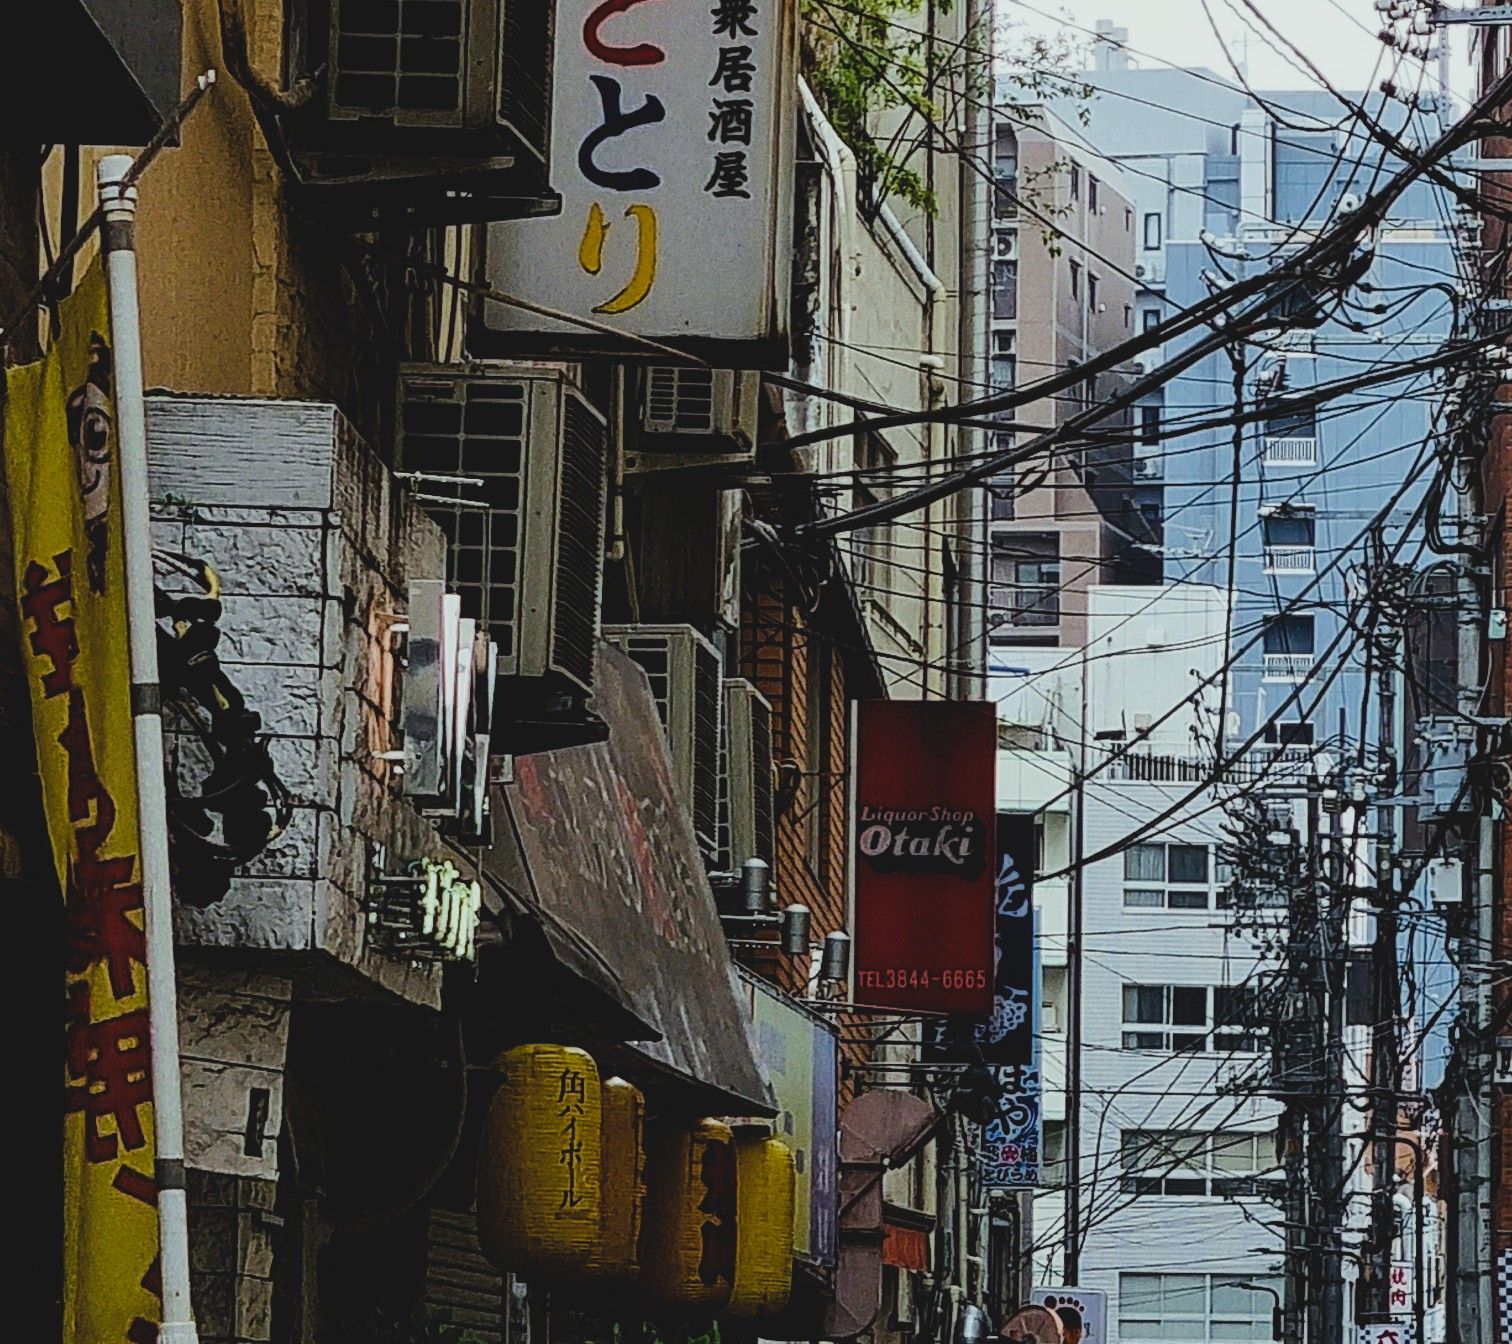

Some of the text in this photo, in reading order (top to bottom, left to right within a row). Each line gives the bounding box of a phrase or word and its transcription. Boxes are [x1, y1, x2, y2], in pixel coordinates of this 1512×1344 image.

[860, 805, 974, 826] Liquor Shop
[859, 824, 974, 865] Otaki
[557, 1068, 585, 1209] 角ハイボール
